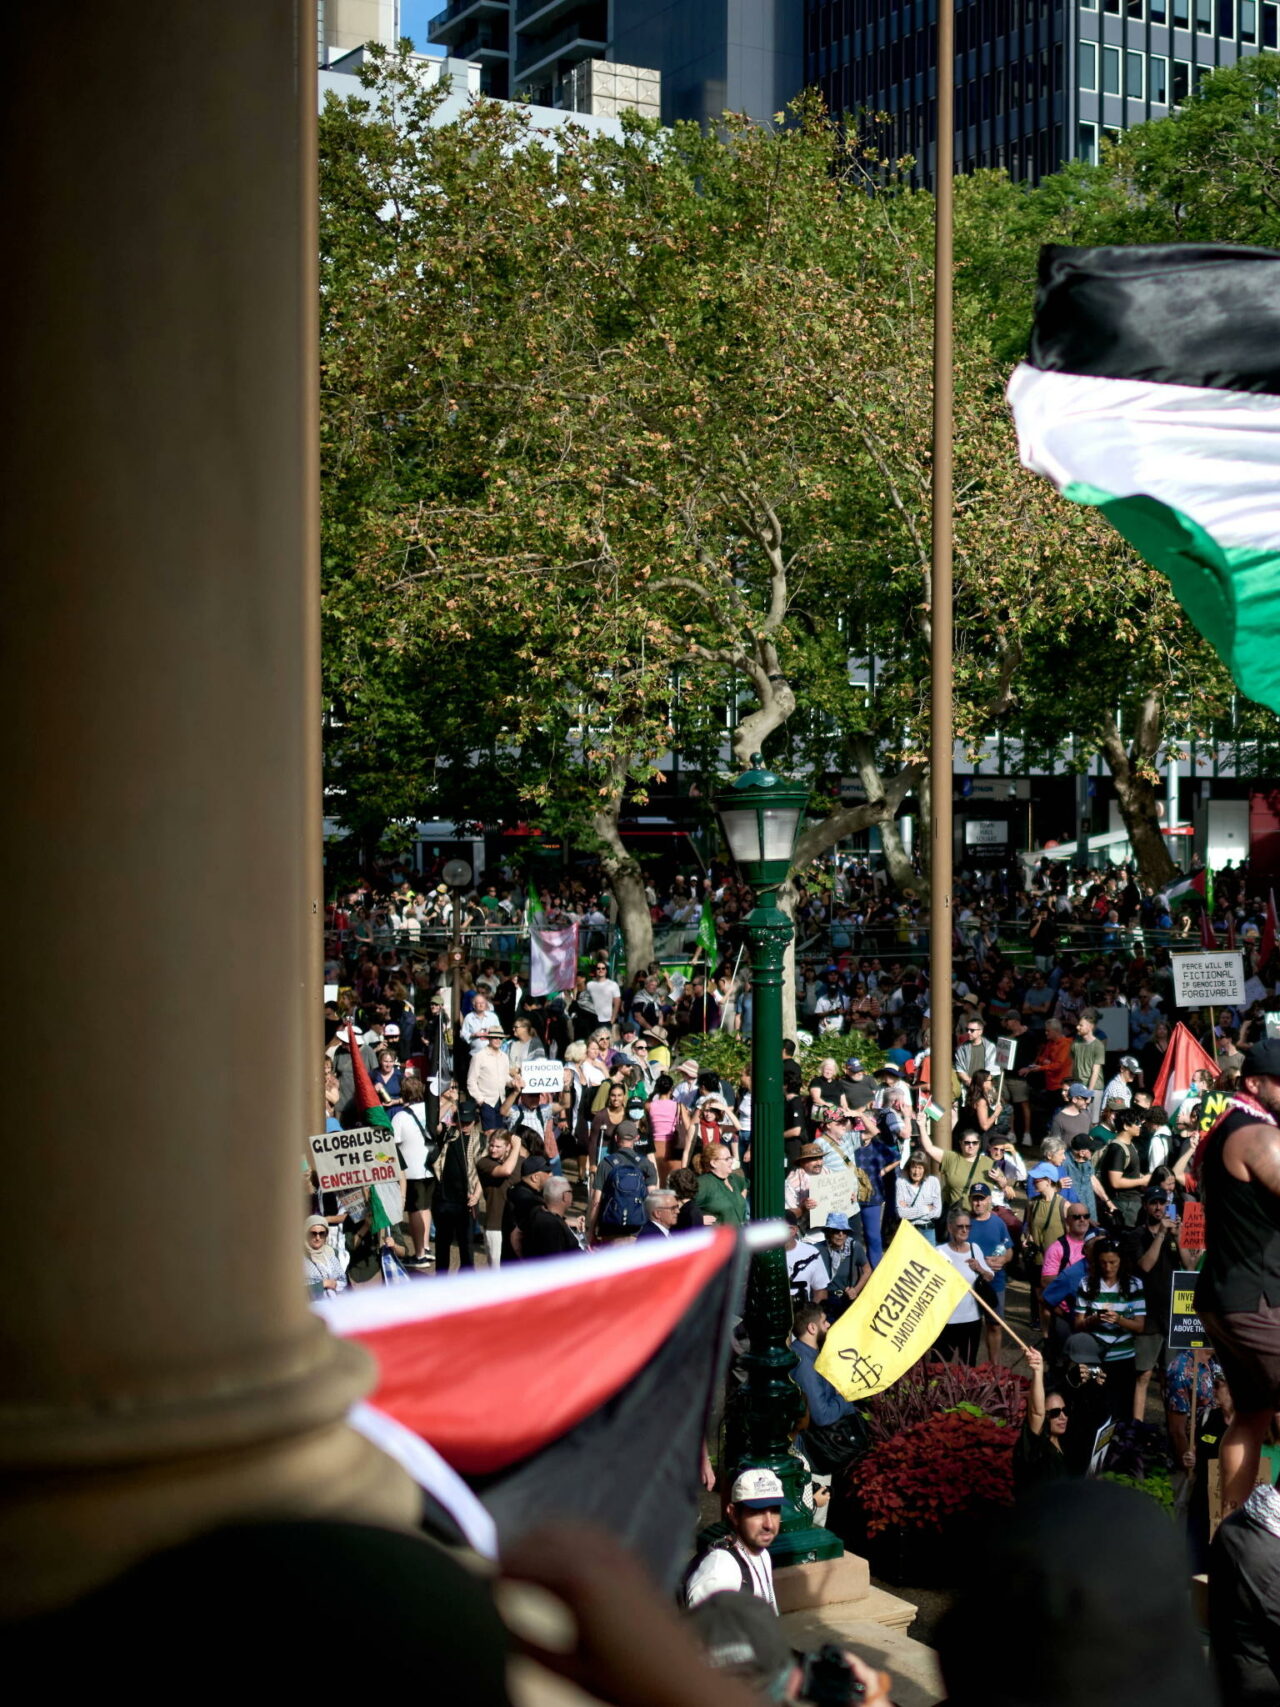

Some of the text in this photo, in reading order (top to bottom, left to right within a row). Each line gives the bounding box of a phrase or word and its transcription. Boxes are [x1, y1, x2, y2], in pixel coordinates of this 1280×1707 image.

[1183, 970, 1234, 980] FICTIONAL
[1182, 988, 1238, 998] FORGIVABLE
[529, 1077, 559, 1087] GAZA
[312, 1128, 391, 1154] GLOBALUSE
[334, 1150, 373, 1166] THE
[320, 1165, 395, 1189] ENCHILADA
[1174, 1325, 1194, 1333] ABOVE
